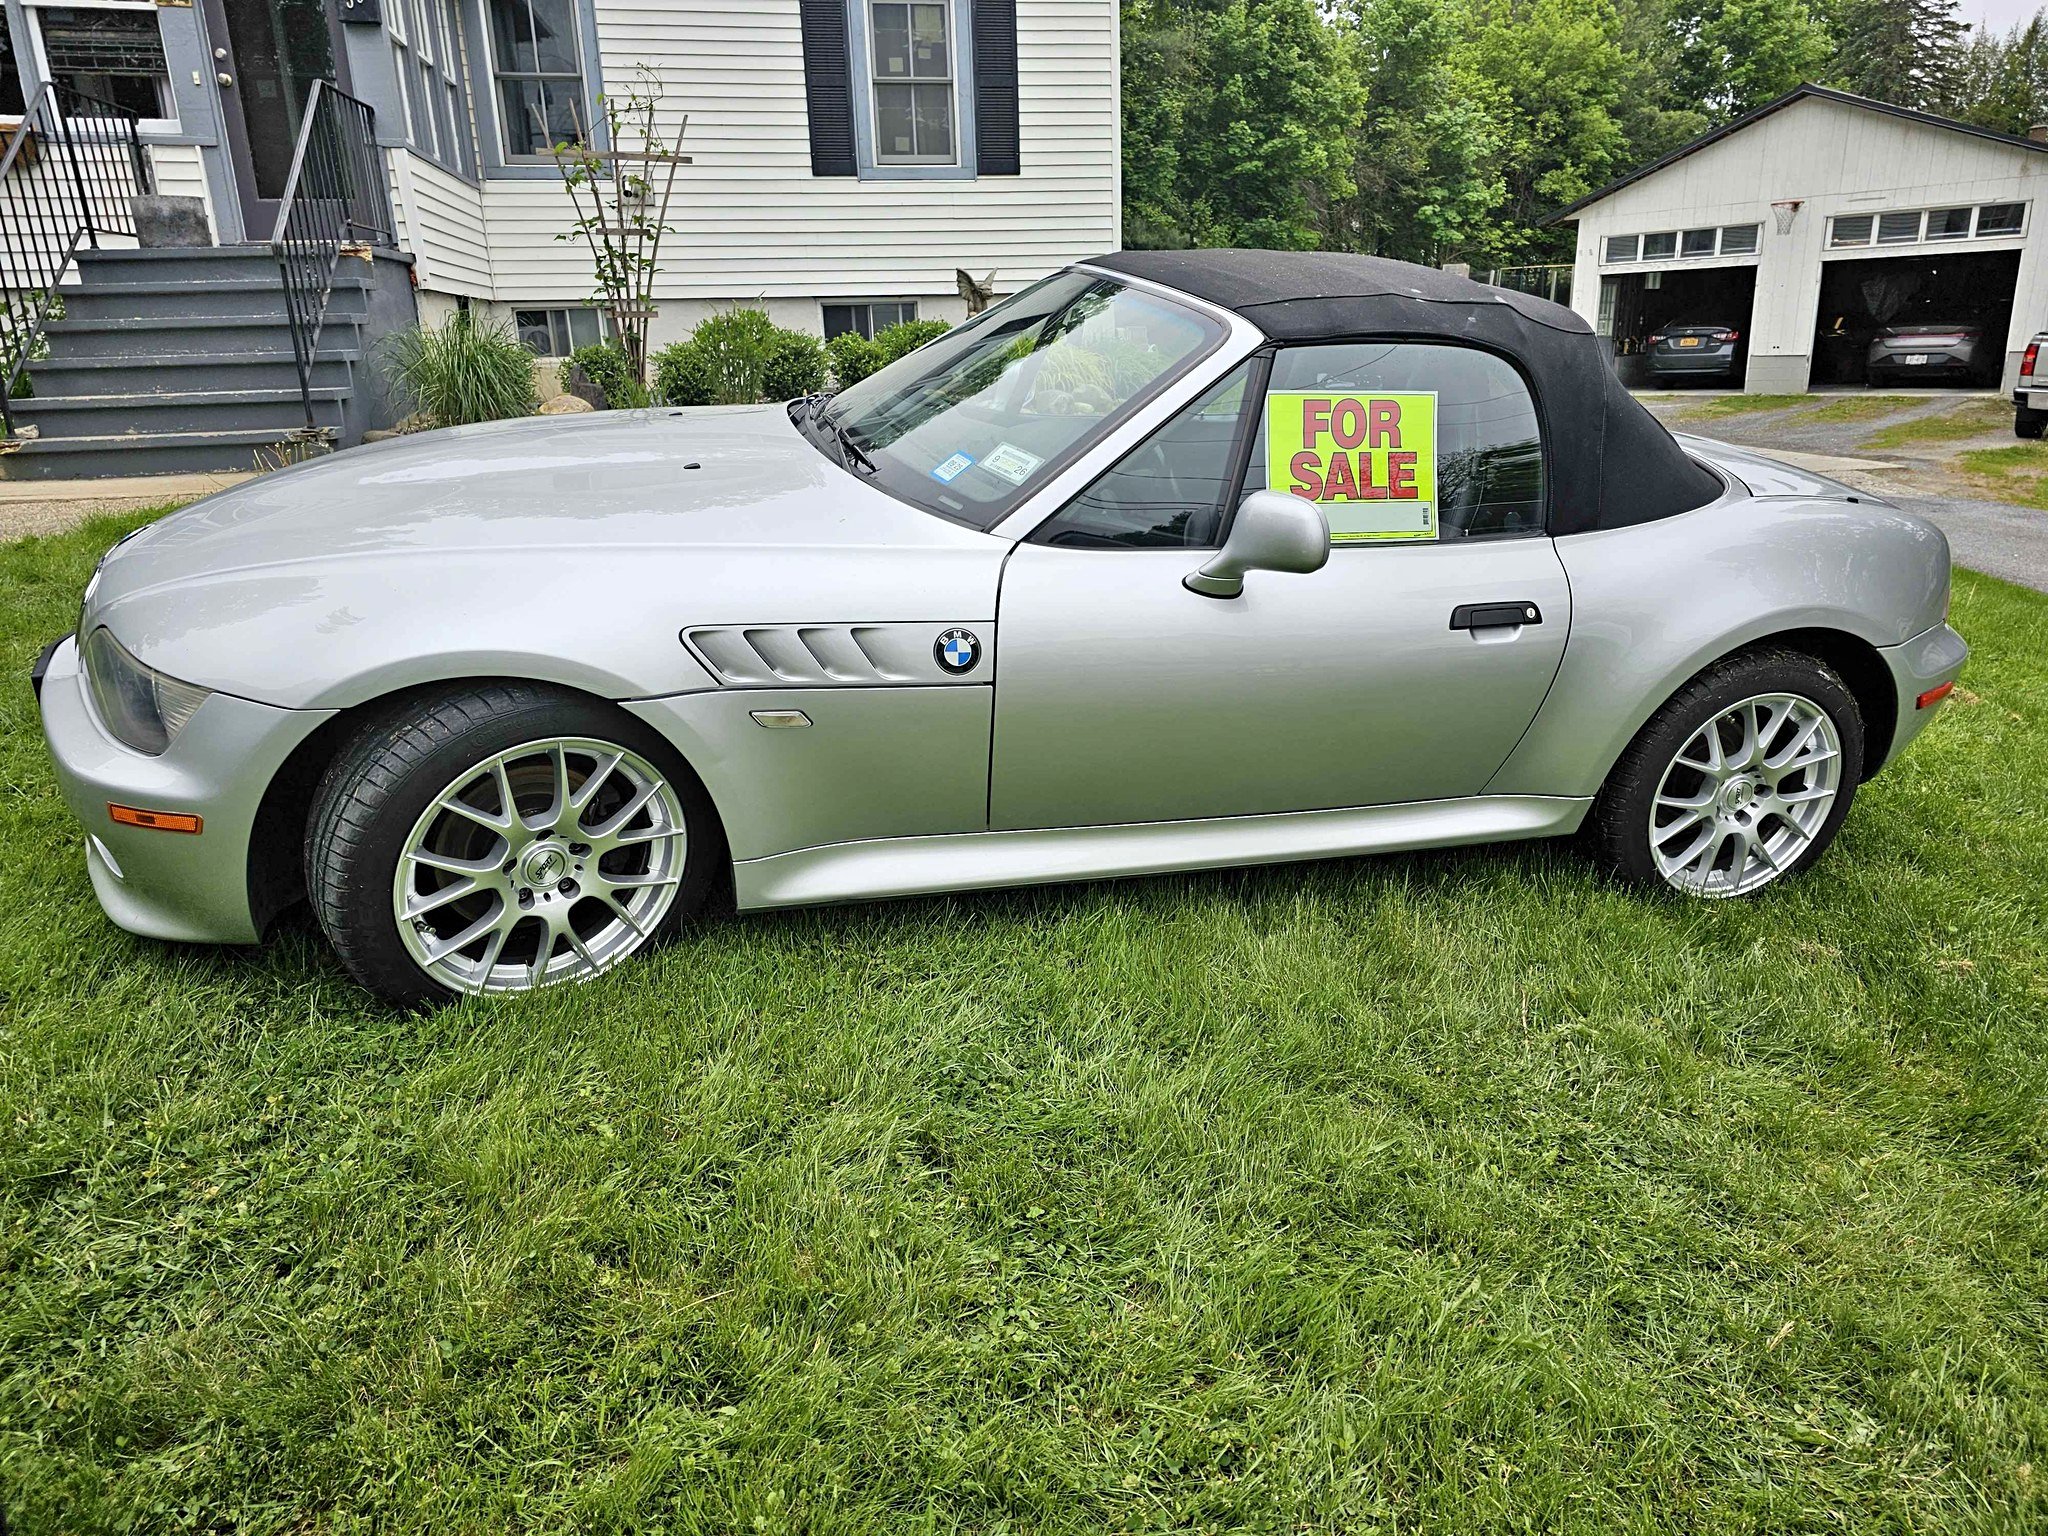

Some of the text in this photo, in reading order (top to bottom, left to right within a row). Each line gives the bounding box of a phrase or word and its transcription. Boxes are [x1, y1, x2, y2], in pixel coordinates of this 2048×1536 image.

[1302, 397, 1402, 450] FOR
[1013, 465, 1028, 476] 26
[1289, 450, 1419, 502] SALE
[939, 630, 976, 646] BMW
